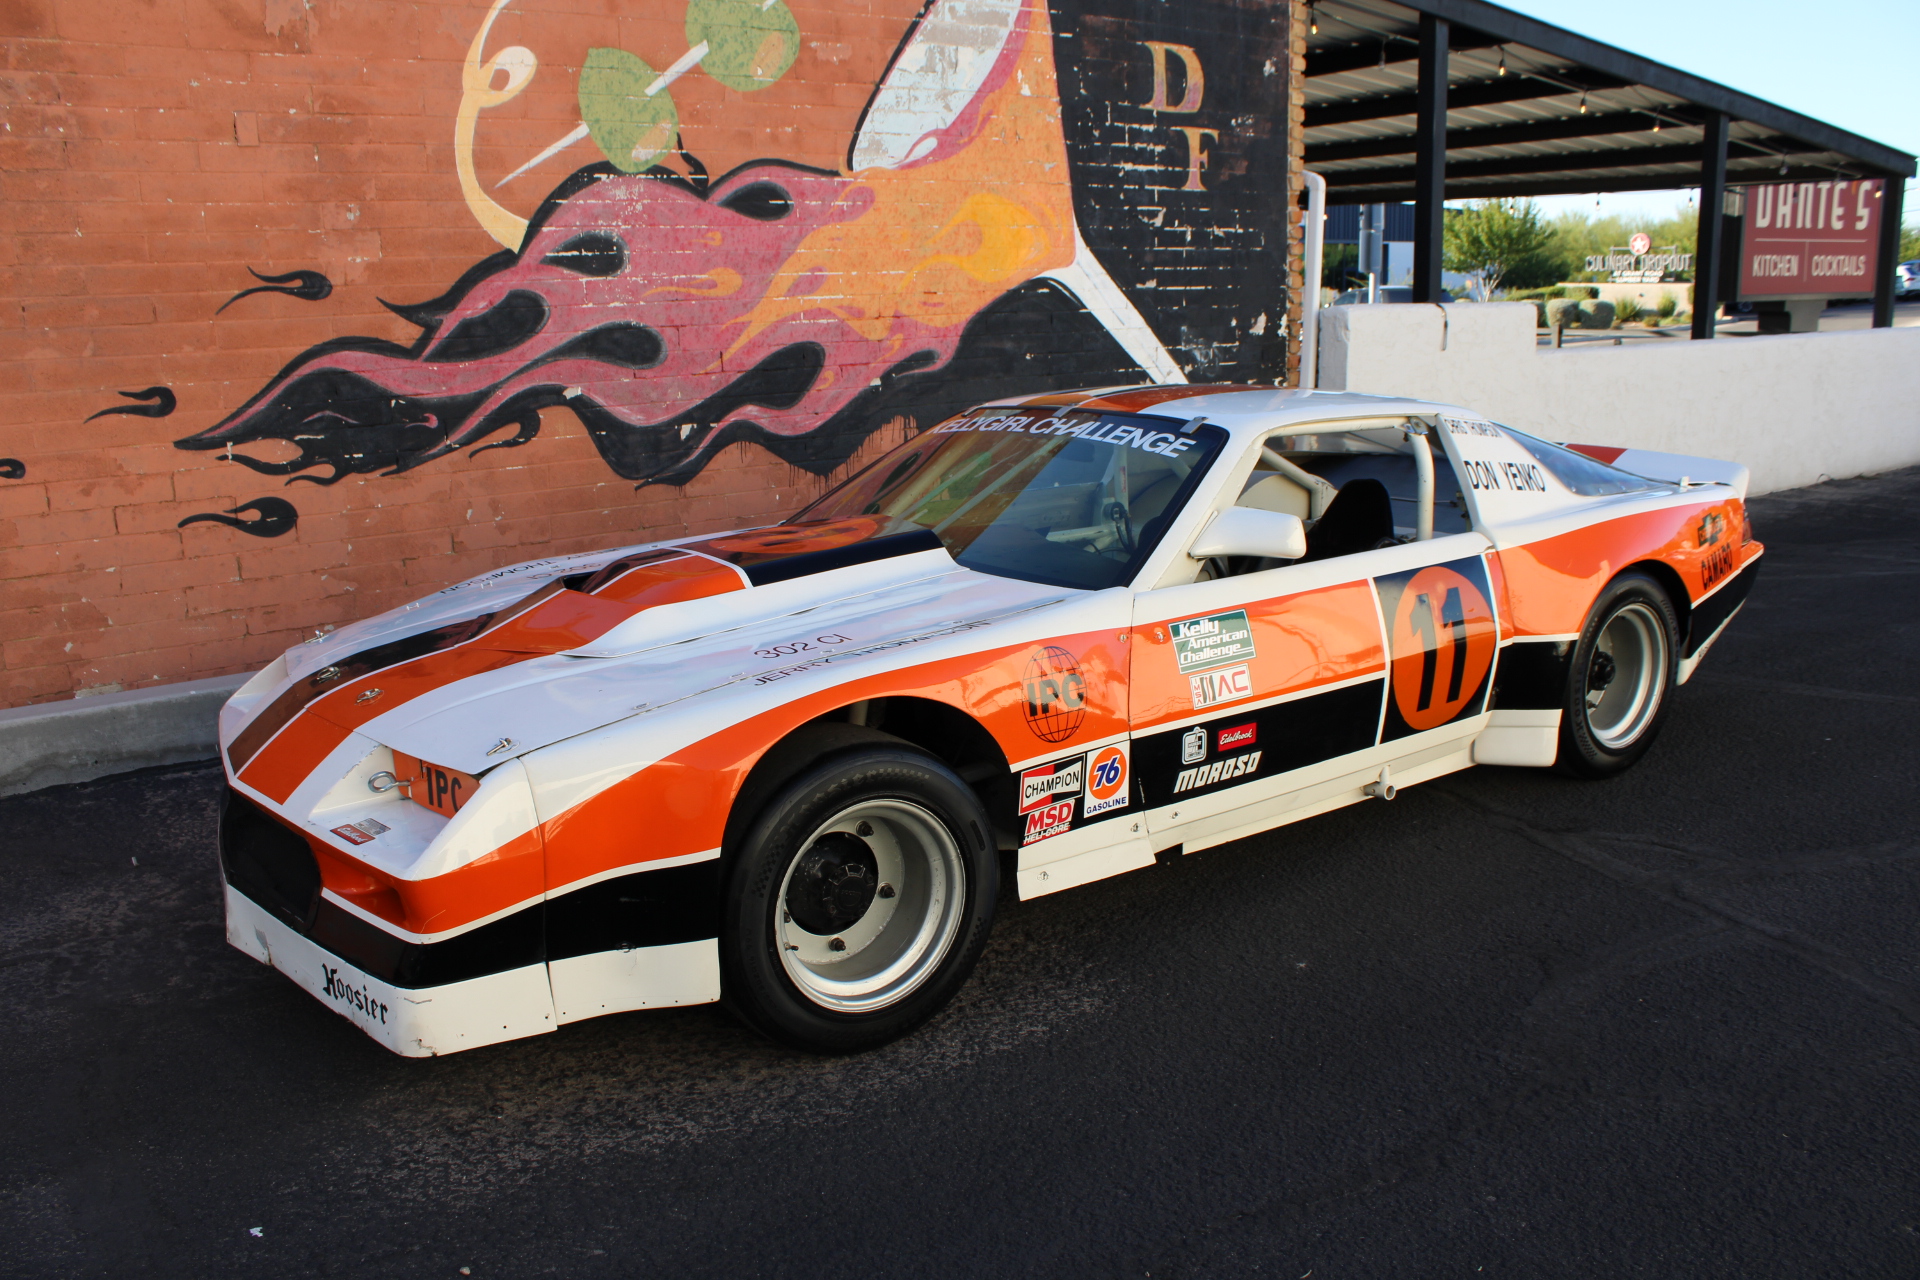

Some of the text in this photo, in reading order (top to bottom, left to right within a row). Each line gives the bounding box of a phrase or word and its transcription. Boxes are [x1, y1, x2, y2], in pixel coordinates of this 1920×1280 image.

[1139, 40, 1204, 113] D
[1180, 126, 1220, 191] F
[1585, 253, 1694, 271] CULINARY DROPOUT
[1752, 255, 1799, 277] KITCHEN
[1811, 255, 1866, 277] COCKTAILS
[927, 415, 1198, 458] KELLYGIRL CHALLENGE
[1463, 460, 1546, 492] DON YENKO
[1701, 542, 1733, 590] CAMARO
[1179, 619, 1219, 638] Kelly
[1188, 629, 1248, 650] American
[754, 633, 853, 659] 302 CI
[1180, 643, 1241, 664] Challenge
[1410, 587, 1467, 712] 11
[754, 658, 833, 686] JERRY
[1027, 673, 1084, 717] IPC
[1220, 729, 1253, 745] Edelbrock
[1025, 770, 1080, 799] CHAMPION
[1094, 755, 1120, 790] 76
[1173, 751, 1262, 793] MOROSO
[427, 767, 462, 812] IPC
[1086, 797, 1127, 814] GASOLINE
[1025, 802, 1073, 835] MSD
[322, 963, 388, 1025] Hoosier
